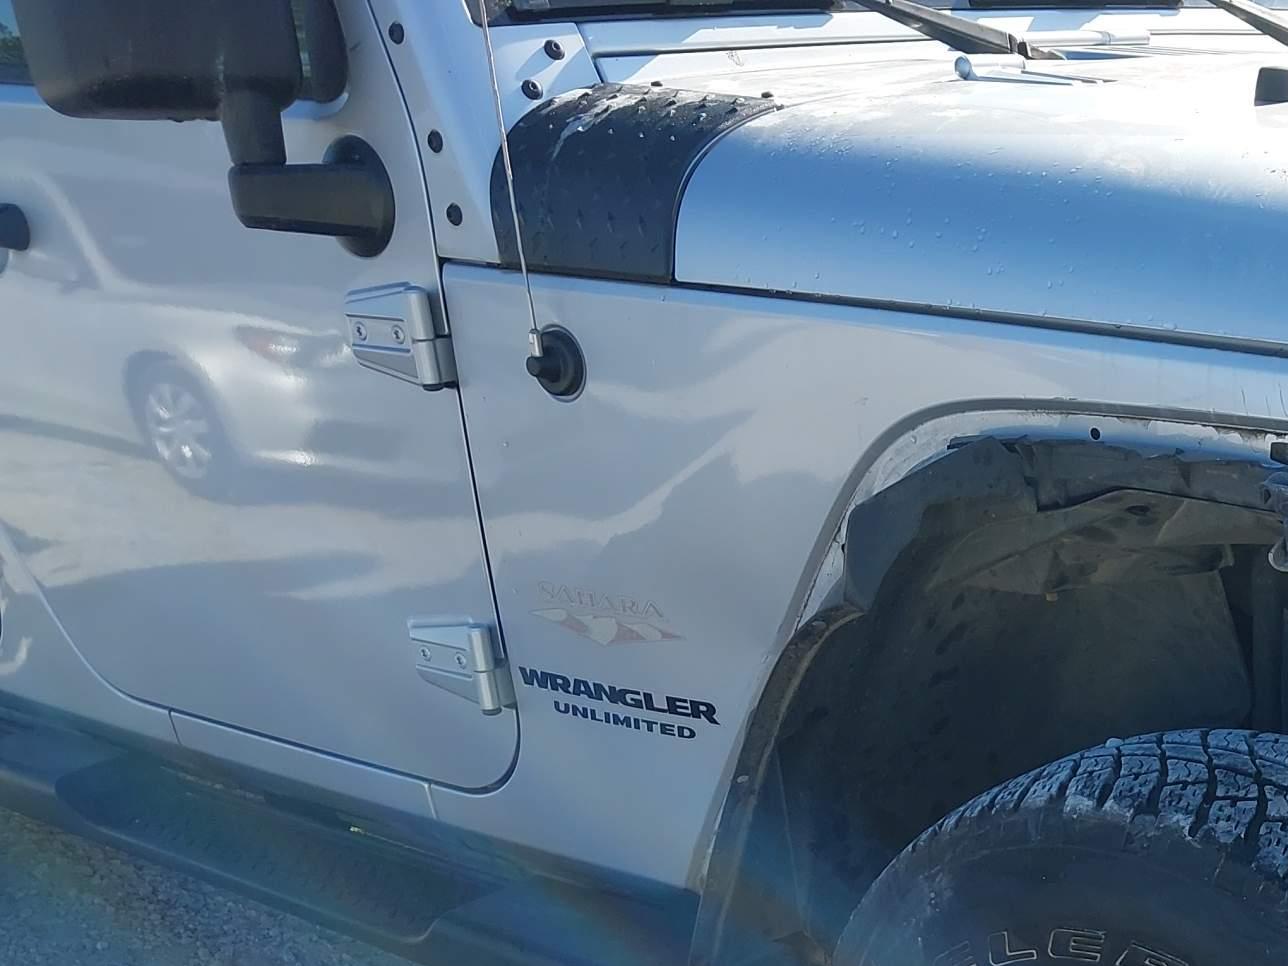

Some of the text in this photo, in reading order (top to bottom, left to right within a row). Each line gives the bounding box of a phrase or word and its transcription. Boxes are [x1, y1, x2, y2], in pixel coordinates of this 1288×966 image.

[539, 582, 664, 617] SAHARA
[518, 666, 721, 726] WRANGLER
[554, 700, 697, 739] UNLIMITED
